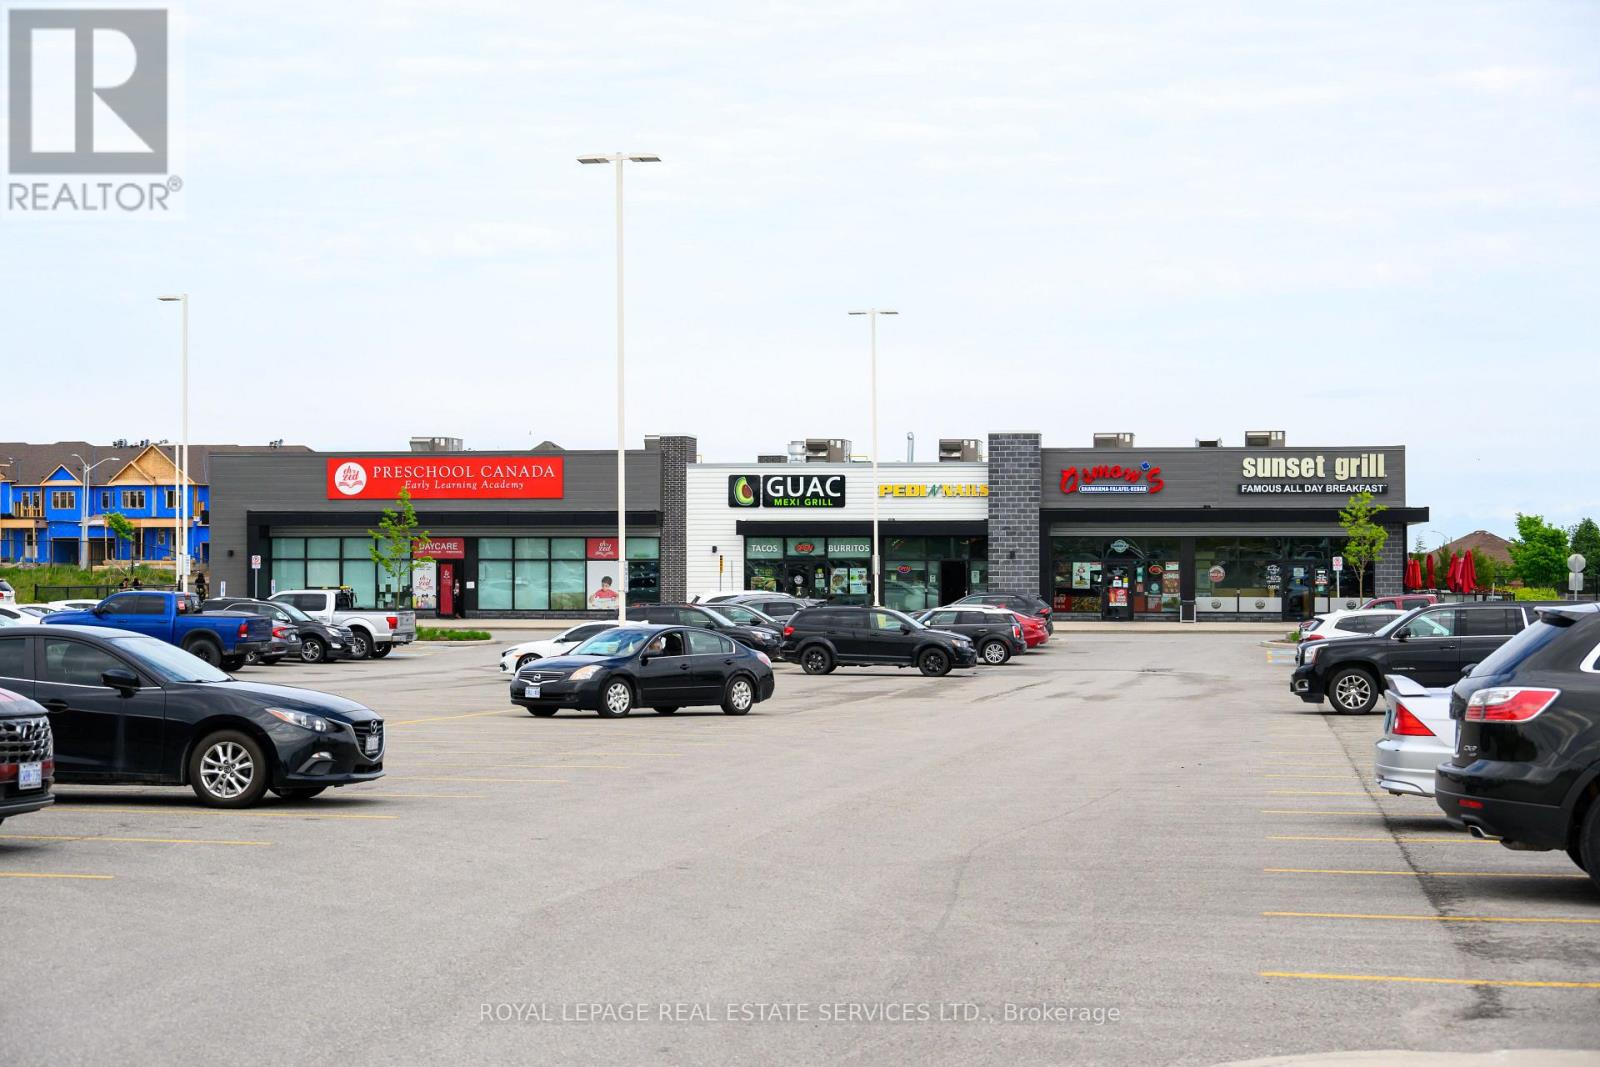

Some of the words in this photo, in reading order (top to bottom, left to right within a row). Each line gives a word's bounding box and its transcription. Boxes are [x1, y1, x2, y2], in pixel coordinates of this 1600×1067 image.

[373, 465, 475, 478] PRESCHOOL
[480, 465, 555, 478] CANADA
[1242, 456, 1326, 478] sunset
[405, 480, 430, 491] Early
[434, 480, 477, 491] Learning
[481, 480, 524, 491] Academy
[766, 476, 841, 497] GUAC
[879, 484, 927, 497] PEDI
[942, 484, 988, 497] NAILS
[1241, 484, 1282, 493] FAMOUS
[1283, 484, 1303, 493] ALL
[1304, 484, 1324, 493] DAY
[774, 498, 799, 506] MEXI
[804, 498, 833, 506] GRILL
[418, 542, 459, 550] DAYCARE
[751, 544, 778, 552] TACOS
[828, 544, 870, 552] BURRITOS
